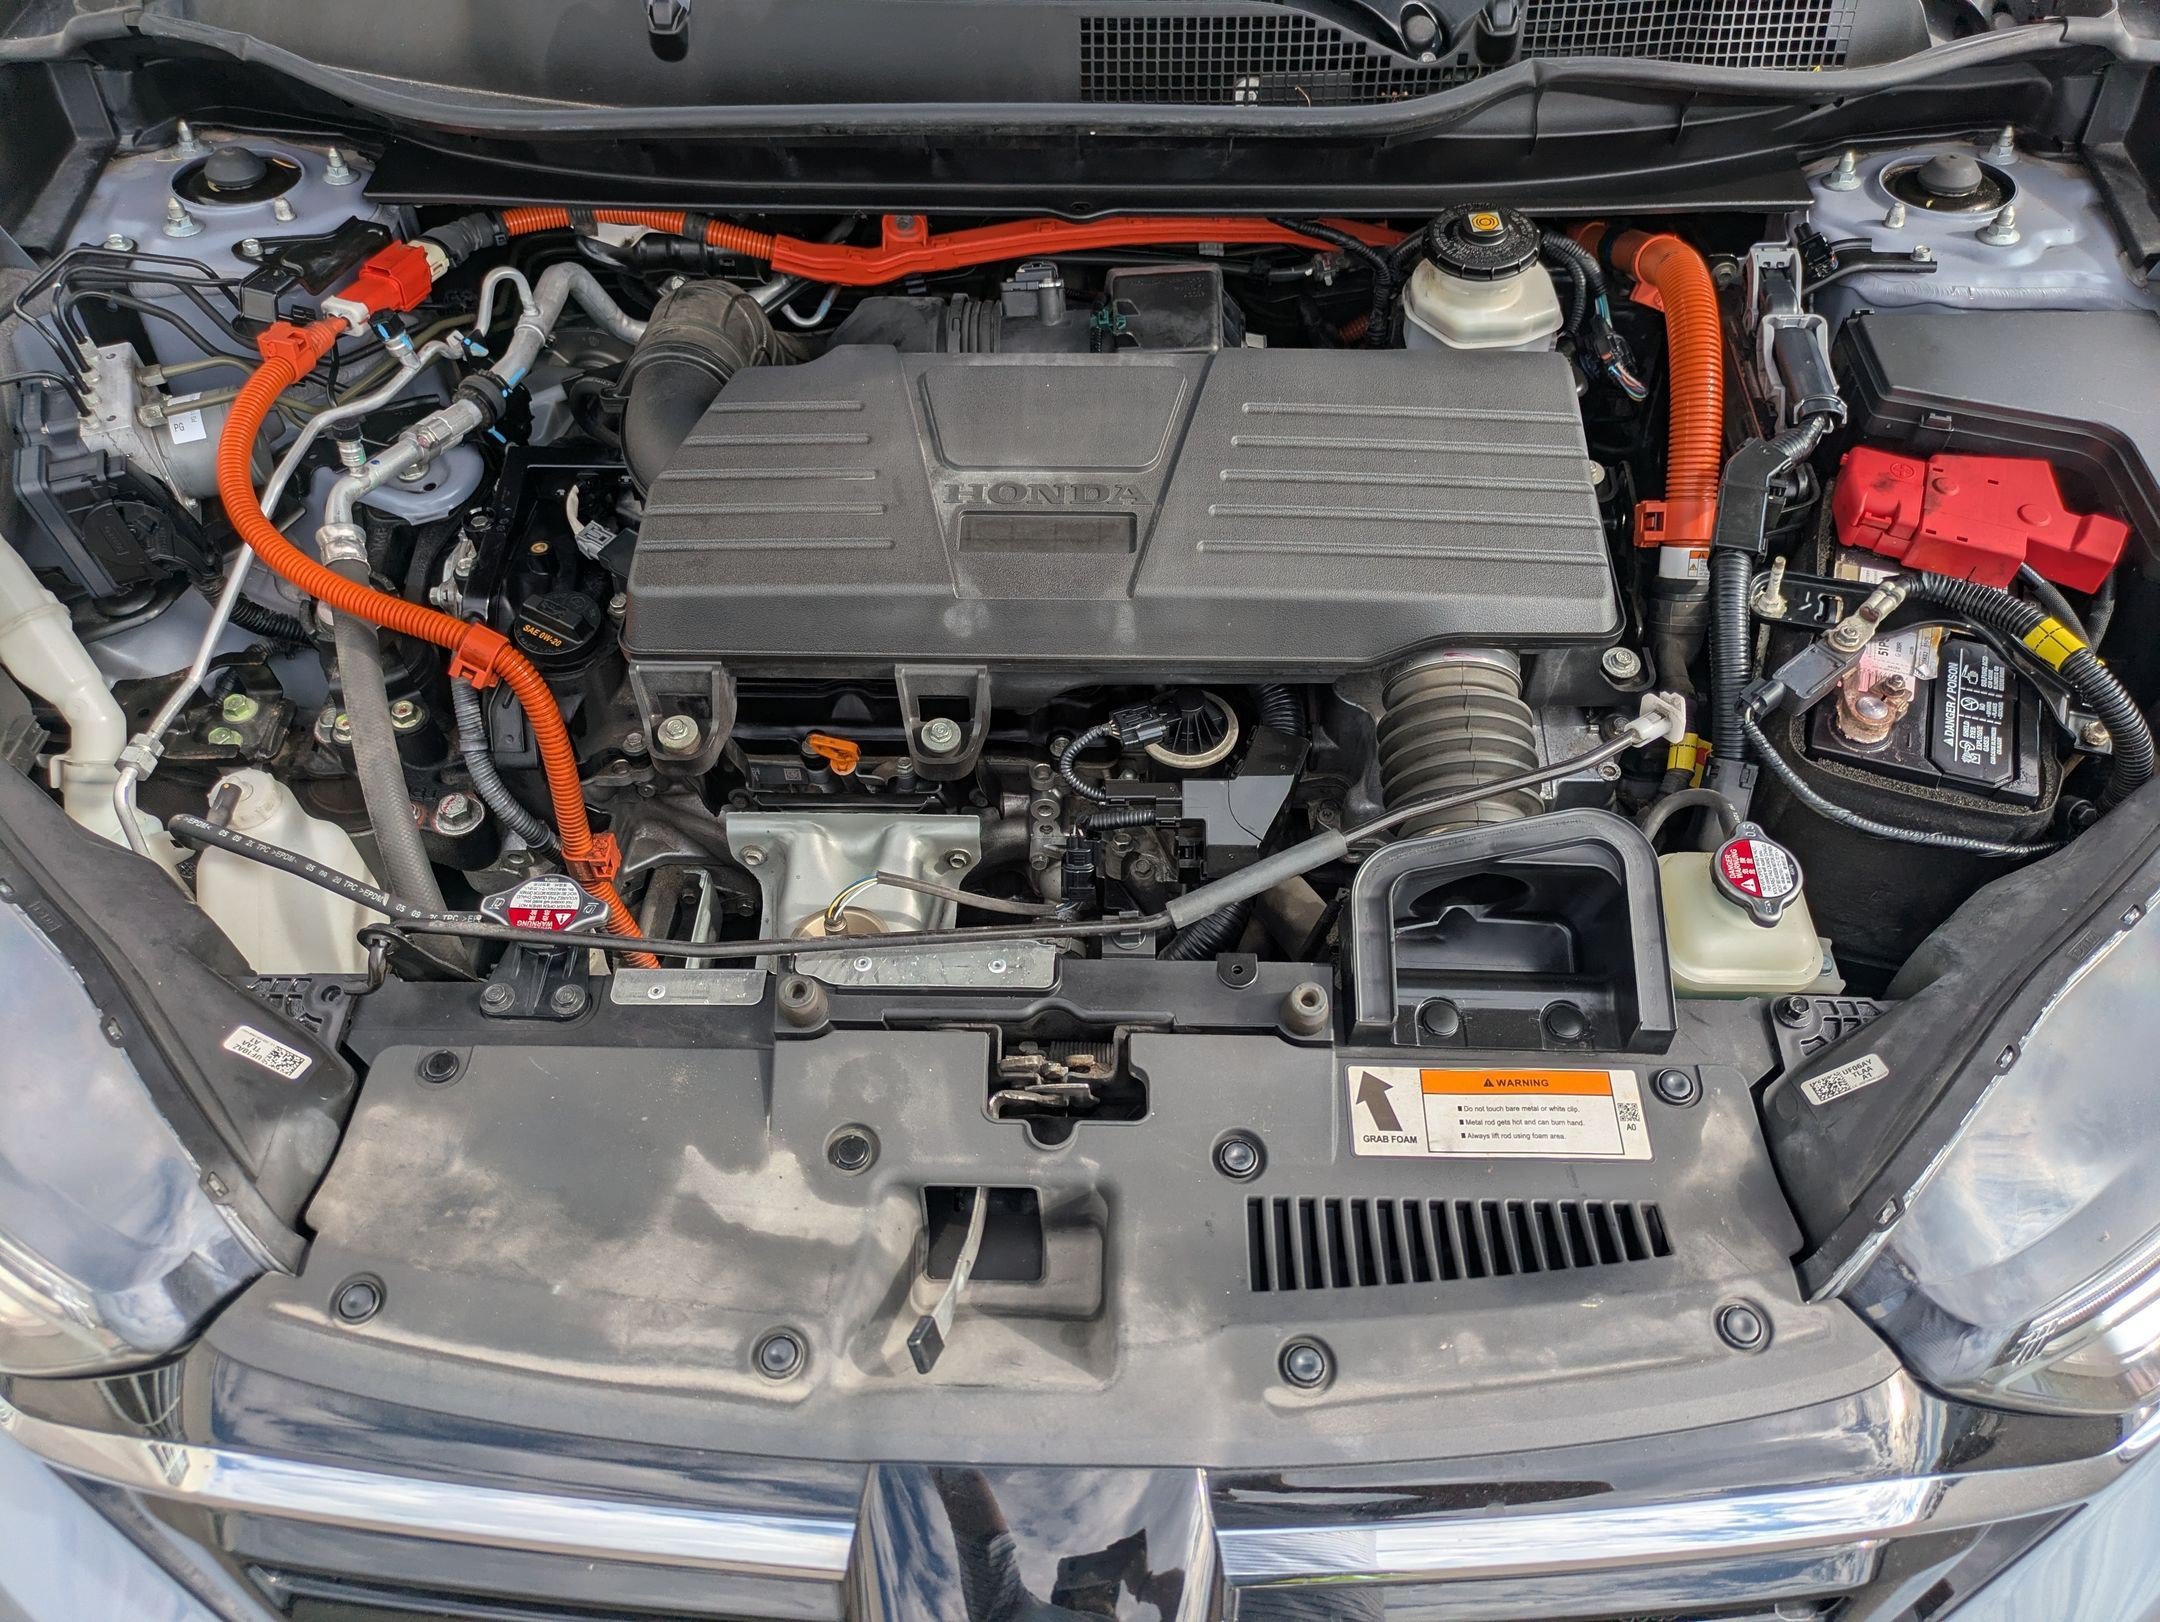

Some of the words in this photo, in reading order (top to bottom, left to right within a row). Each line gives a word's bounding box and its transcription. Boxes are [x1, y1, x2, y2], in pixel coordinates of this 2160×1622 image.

[173, 422, 185, 432] PG
[943, 481, 1154, 506] HONDA
[522, 624, 540, 637] SAE
[539, 632, 562, 647] 0W-20
[1946, 661, 1959, 694] POISON
[1944, 701, 1957, 738] DANGER
[1725, 854, 1736, 878] DANGER
[256, 844, 271, 853] TPC
[344, 880, 359, 891] TPC
[395, 903, 407, 912] 05
[516, 920, 552, 929] WARNUNG
[242, 1040, 262, 1053] TLAA
[1852, 1066, 1873, 1078] TLAA
[1862, 1073, 1873, 1081] A1
[1496, 1078, 1549, 1087] WARNING
[1497, 1119, 1511, 1127] gets
[1363, 1134, 1389, 1144] GRAB
[1391, 1134, 1418, 1144] FOAM
[1467, 1132, 1490, 1140] Always
[1513, 1132, 1531, 1140] using
